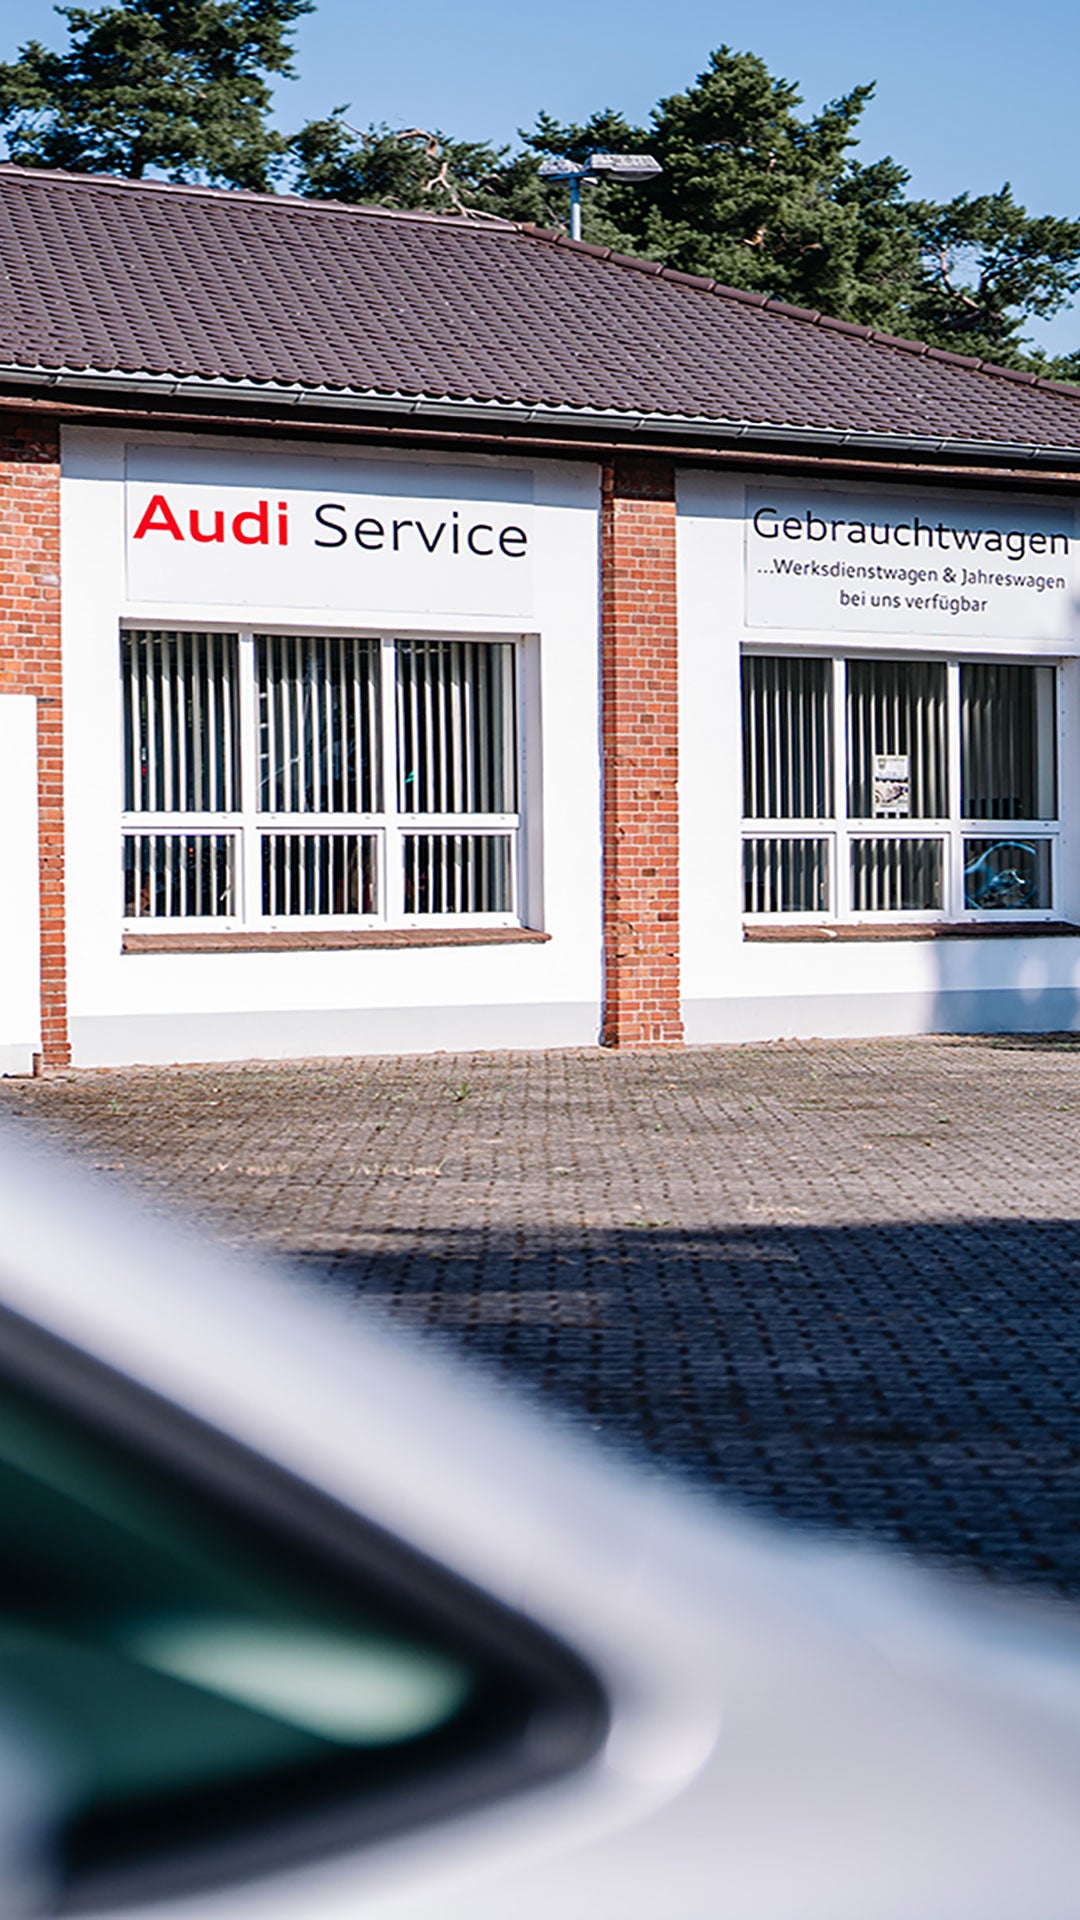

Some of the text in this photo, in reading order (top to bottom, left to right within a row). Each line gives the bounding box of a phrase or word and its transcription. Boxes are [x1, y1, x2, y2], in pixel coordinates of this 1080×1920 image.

[133, 494, 528, 557] Audi Service
[753, 507, 1070, 561] Gebrauchtwagen
[943, 567, 957, 584] &
[960, 567, 1066, 592] Jahreswagen
[839, 589, 988, 615] bei uns verfügbar
